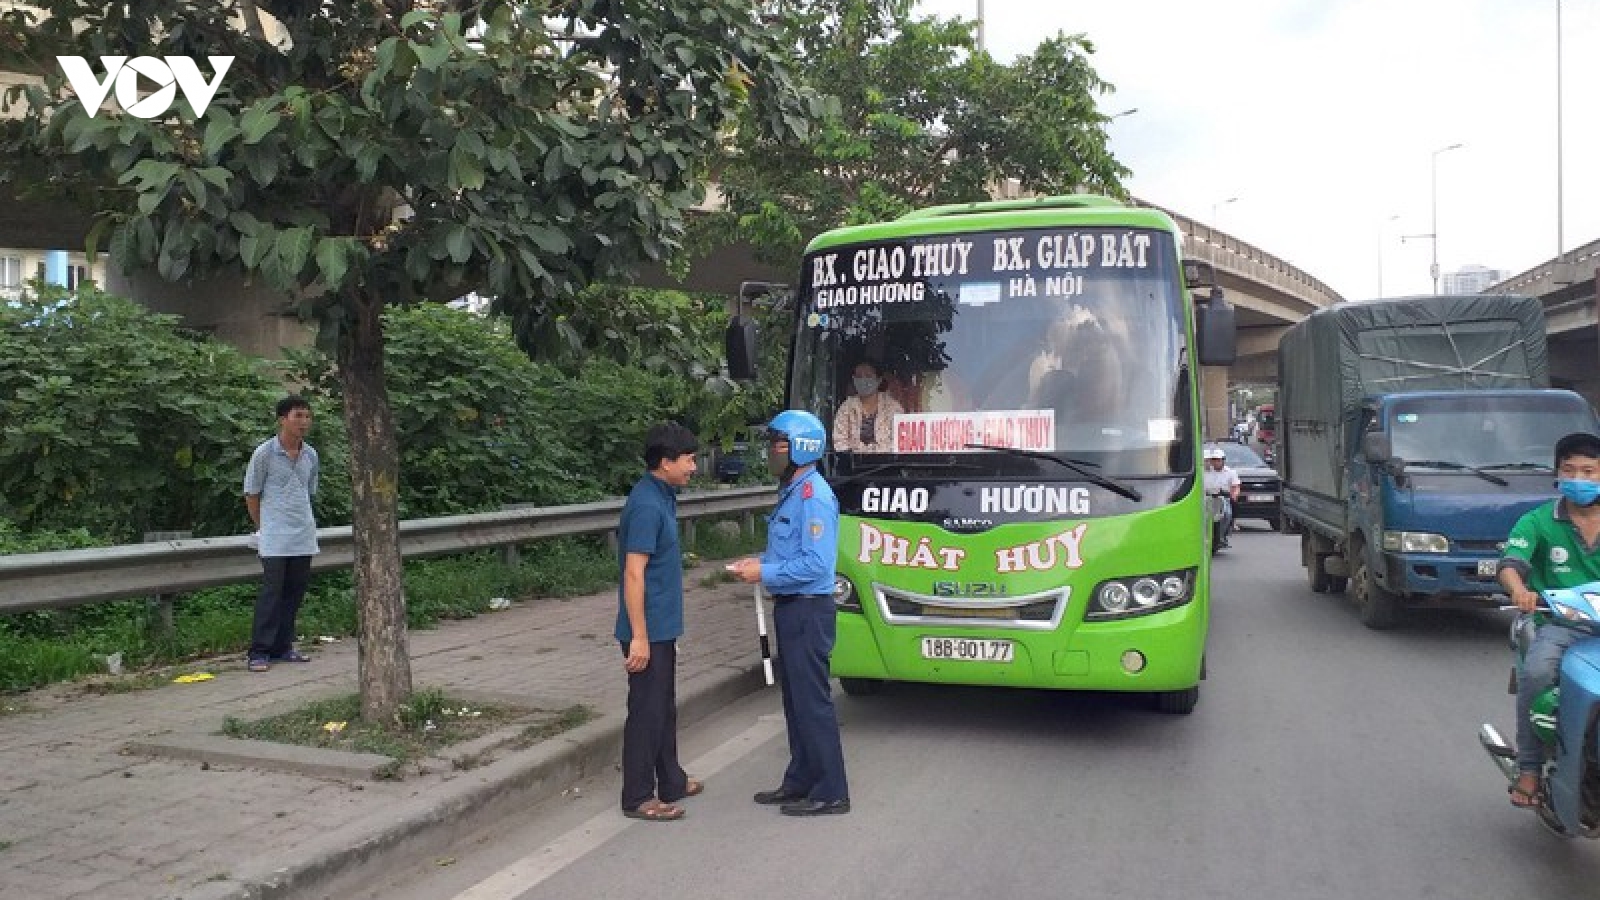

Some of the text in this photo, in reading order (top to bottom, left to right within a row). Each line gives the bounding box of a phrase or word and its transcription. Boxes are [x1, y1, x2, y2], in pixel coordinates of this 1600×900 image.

[853, 245, 906, 282] GIAO
[1037, 231, 1096, 270] GIÁP
[1101, 231, 1151, 269] BÁT
[817, 284, 857, 309] GIAO
[1009, 273, 1037, 298] HÀ
[1045, 271, 1083, 300] NỘI
[897, 421, 927, 452] GIAO
[861, 484, 1091, 514] GIAO HƯƠNG
[858, 521, 1088, 574] PHÁT HUY
[933, 581, 1007, 597] ISUZU
